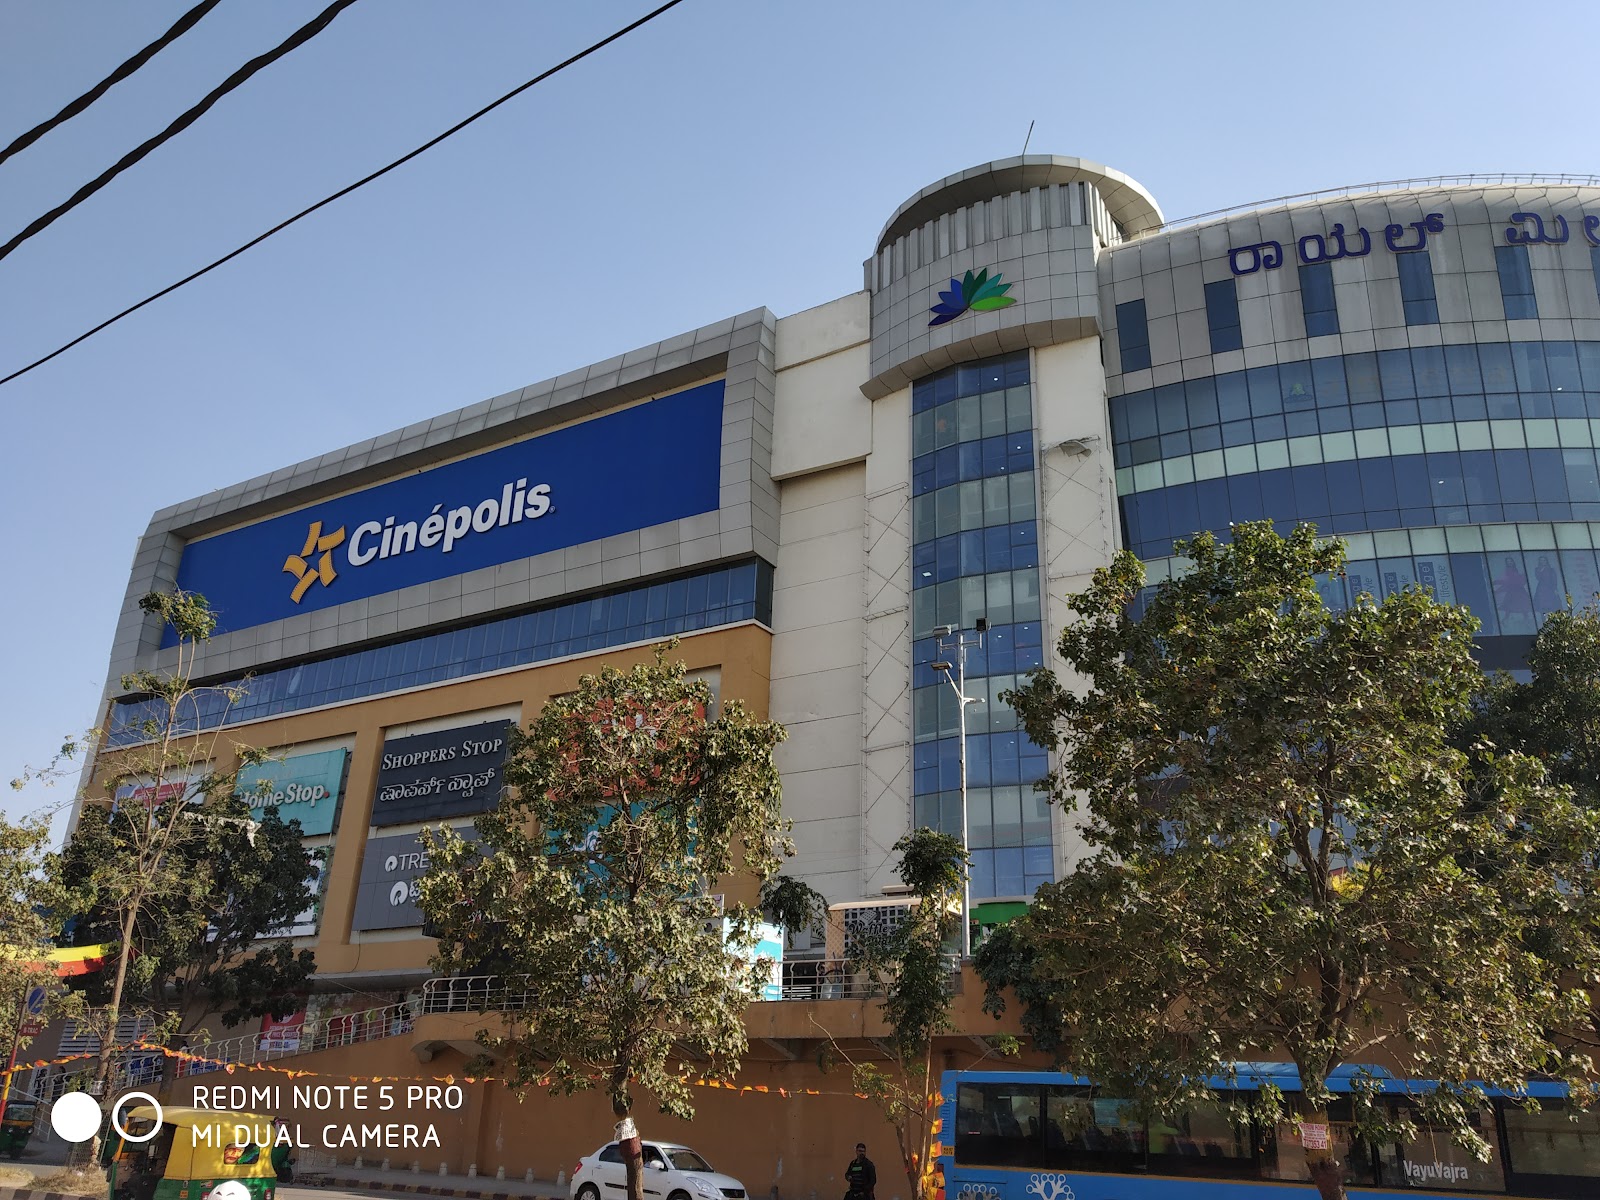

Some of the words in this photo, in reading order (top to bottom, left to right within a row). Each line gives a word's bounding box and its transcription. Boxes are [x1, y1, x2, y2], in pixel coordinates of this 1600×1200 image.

[347, 477, 552, 567] Cinépolis
[382, 746, 457, 770] SHOPPERS
[461, 738, 503, 758] STOP
[1403, 1160, 1469, 1183] VayuVajra
